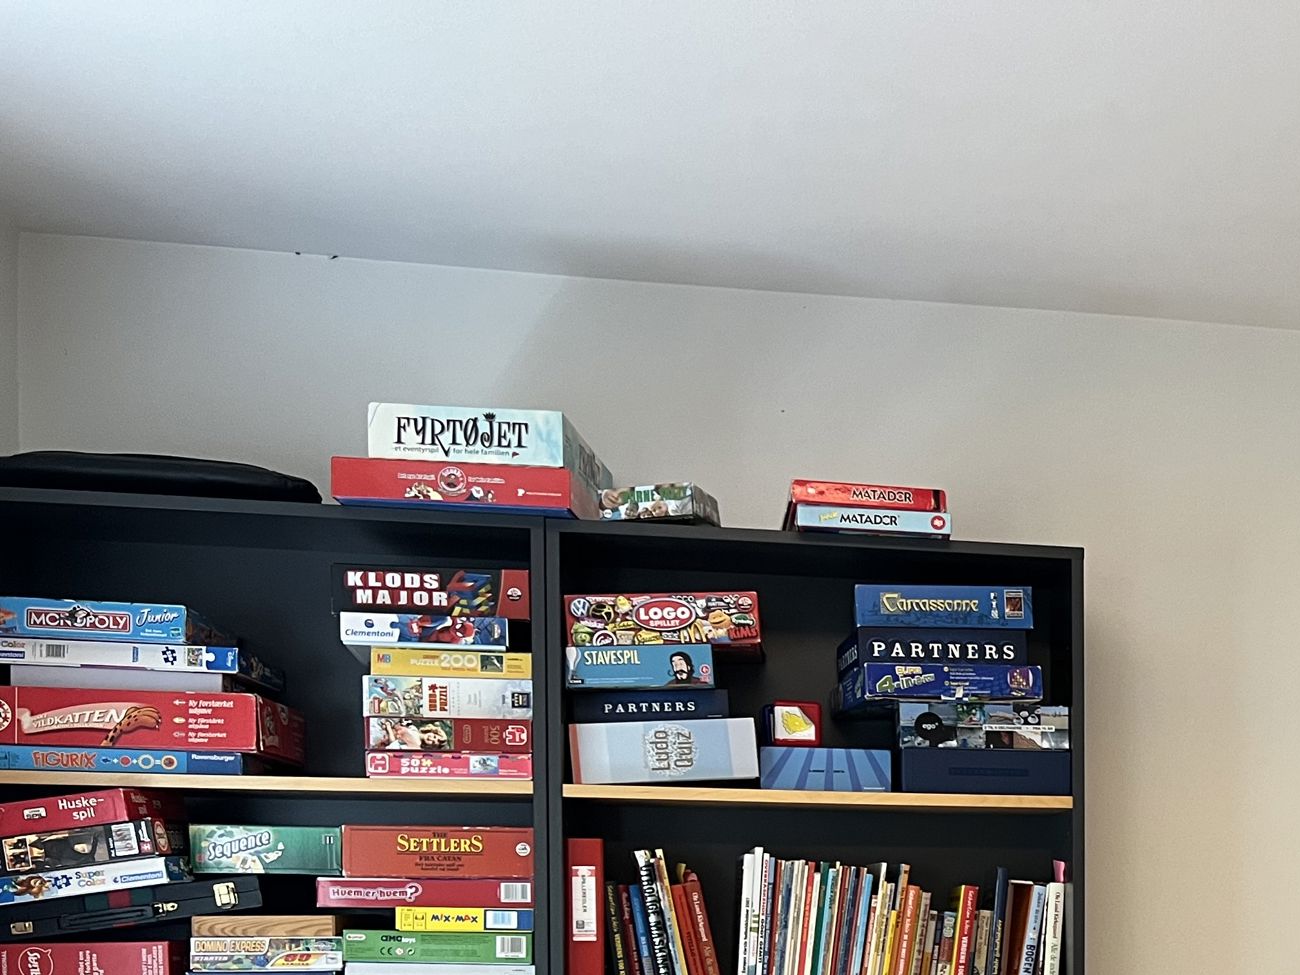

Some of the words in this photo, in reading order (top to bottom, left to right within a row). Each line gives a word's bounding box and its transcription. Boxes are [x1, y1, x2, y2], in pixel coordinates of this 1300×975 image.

[394, 413, 529, 457] FYRTØJET
[850, 489, 913, 503] MATADOR
[839, 513, 899, 526] MATADOR
[346, 571, 440, 589] KLODS
[356, 589, 448, 606] MAJOR
[881, 592, 979, 613] Carcassonne
[136, 609, 180, 628] Junior
[639, 606, 691, 621] LOGO
[345, 628, 394, 638] Clementoni
[584, 650, 640, 665] STAVESPIL
[872, 642, 1015, 660] PARTNERS
[376, 653, 391, 664] MB
[440, 654, 478, 667] 200
[604, 701, 696, 714] PARTNERS
[32, 709, 127, 729] VILDKATTEN
[650, 730, 670, 771] Ludo
[673, 731, 693, 768] Quiz
[32, 751, 97, 768] FIGURIX
[58, 796, 104, 810] Huske-
[72, 806, 95, 821] spil
[208, 831, 271, 861] Sequence
[397, 834, 483, 853] SETTLERS
[693, 901, 702, 914] Lund
[195, 941, 228, 953] DOMINO
[230, 940, 266, 953] EXPRESS
[959, 936, 968, 963] VERDENS
[1022, 944, 1035, 974] BOGEN
